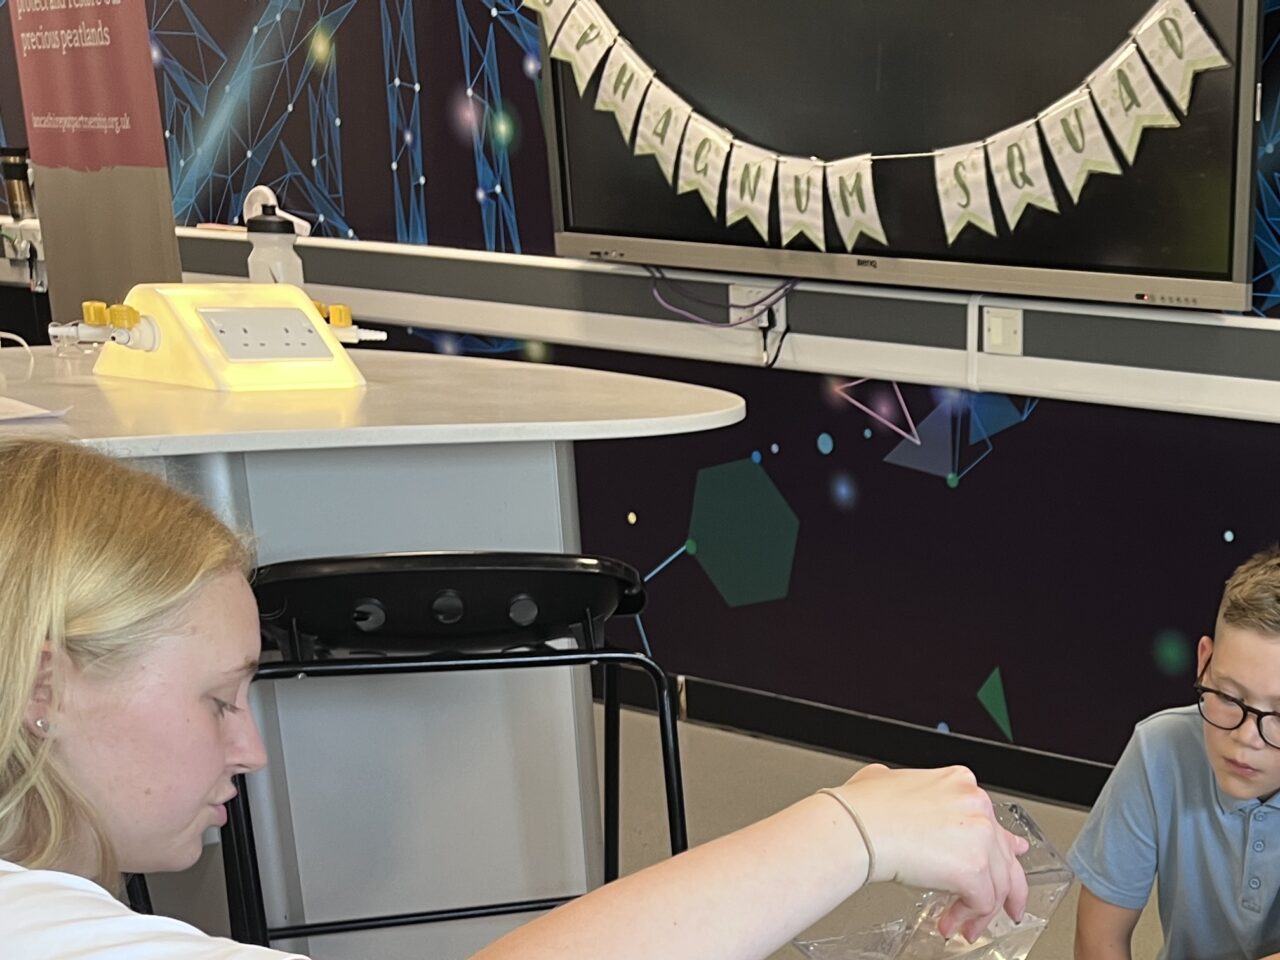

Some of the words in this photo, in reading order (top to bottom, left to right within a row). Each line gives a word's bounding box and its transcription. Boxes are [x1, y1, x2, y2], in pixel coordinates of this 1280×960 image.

[20, 24, 60, 57] precious
[61, 20, 110, 55] peatlands
[543, 0, 868, 218] PHAGNUM
[953, 16, 1184, 209] SQUAD
